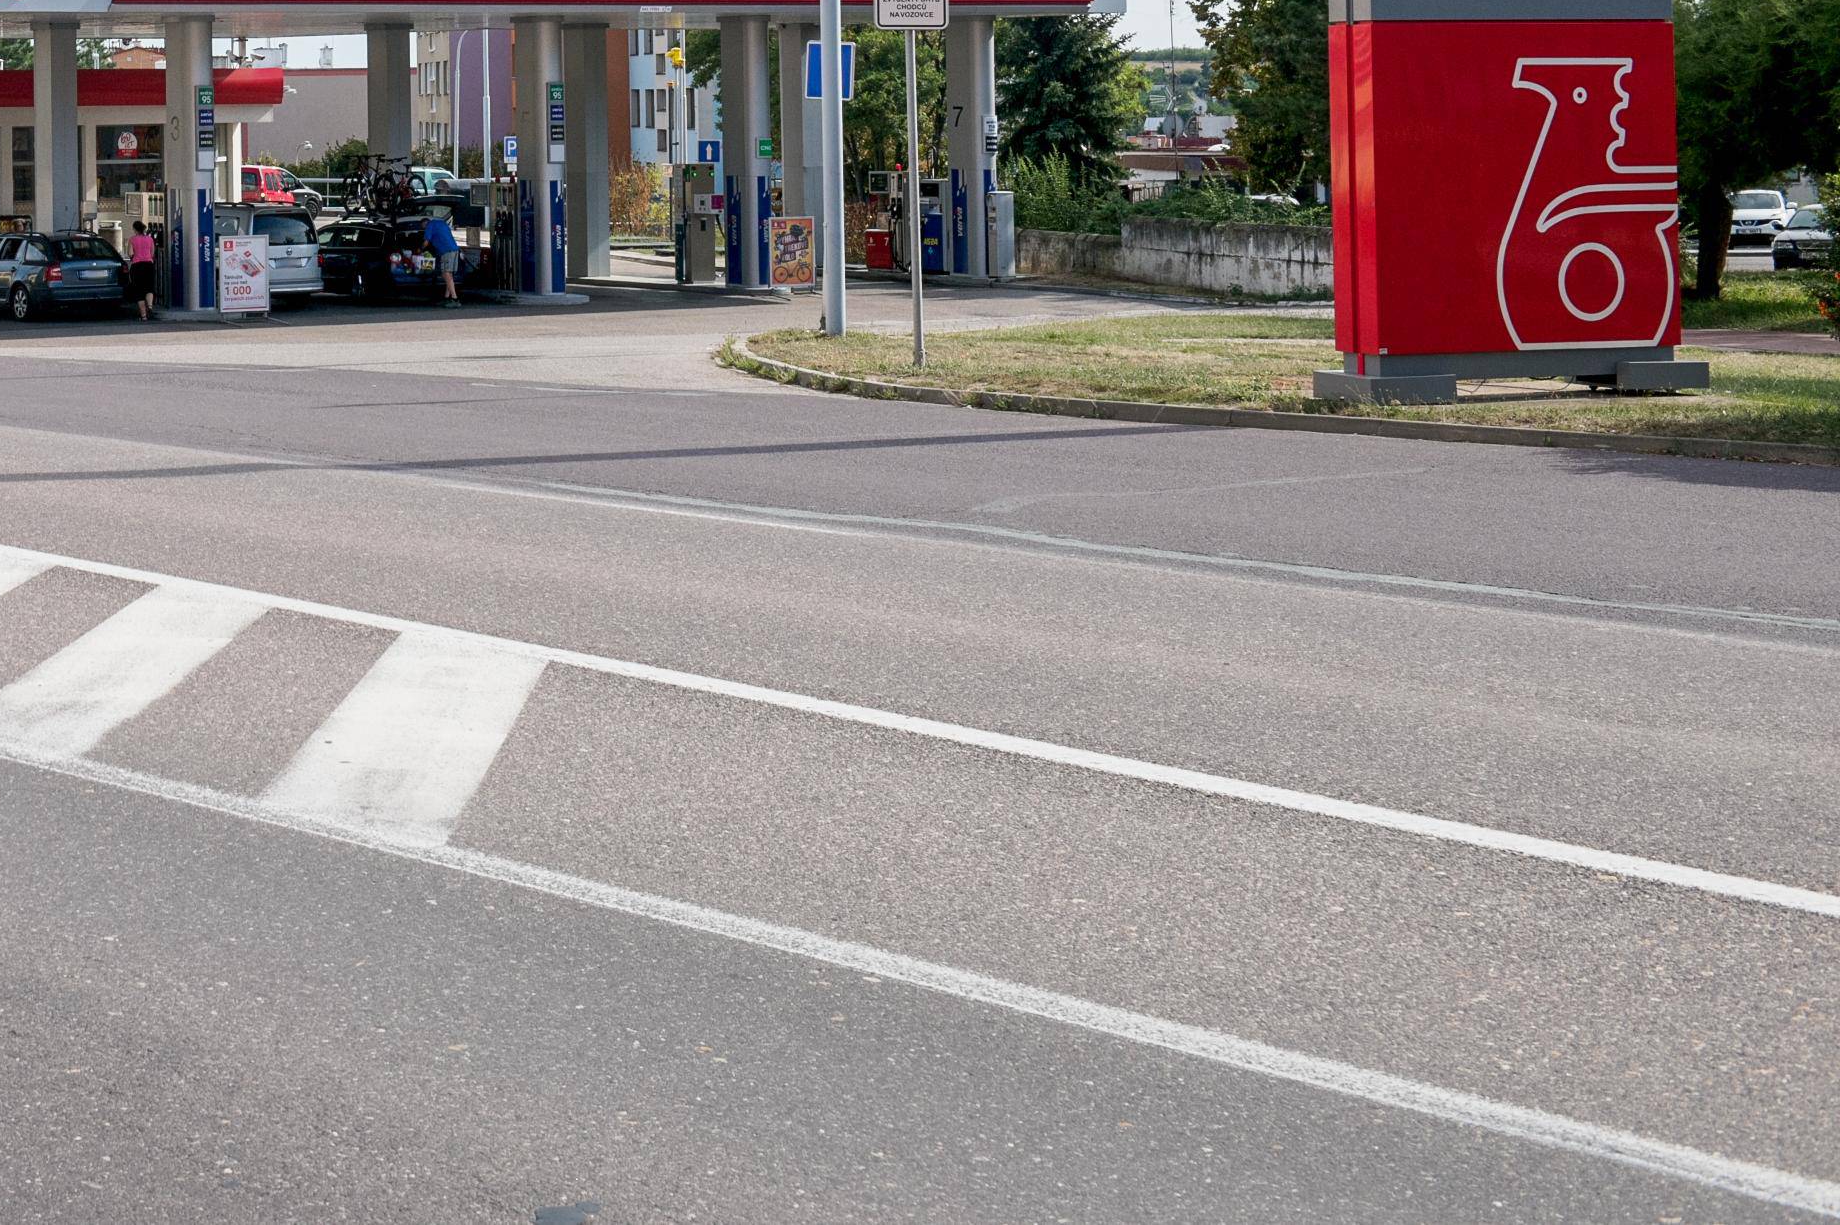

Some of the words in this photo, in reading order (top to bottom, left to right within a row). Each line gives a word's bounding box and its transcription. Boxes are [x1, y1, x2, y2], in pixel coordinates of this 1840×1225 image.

[201, 96, 211, 104] 95
[552, 92, 562, 100] 95
[953, 106, 963, 127] 7
[171, 116, 180, 141] 3
[507, 140, 517, 156] P
[233, 285, 251, 295] 000
